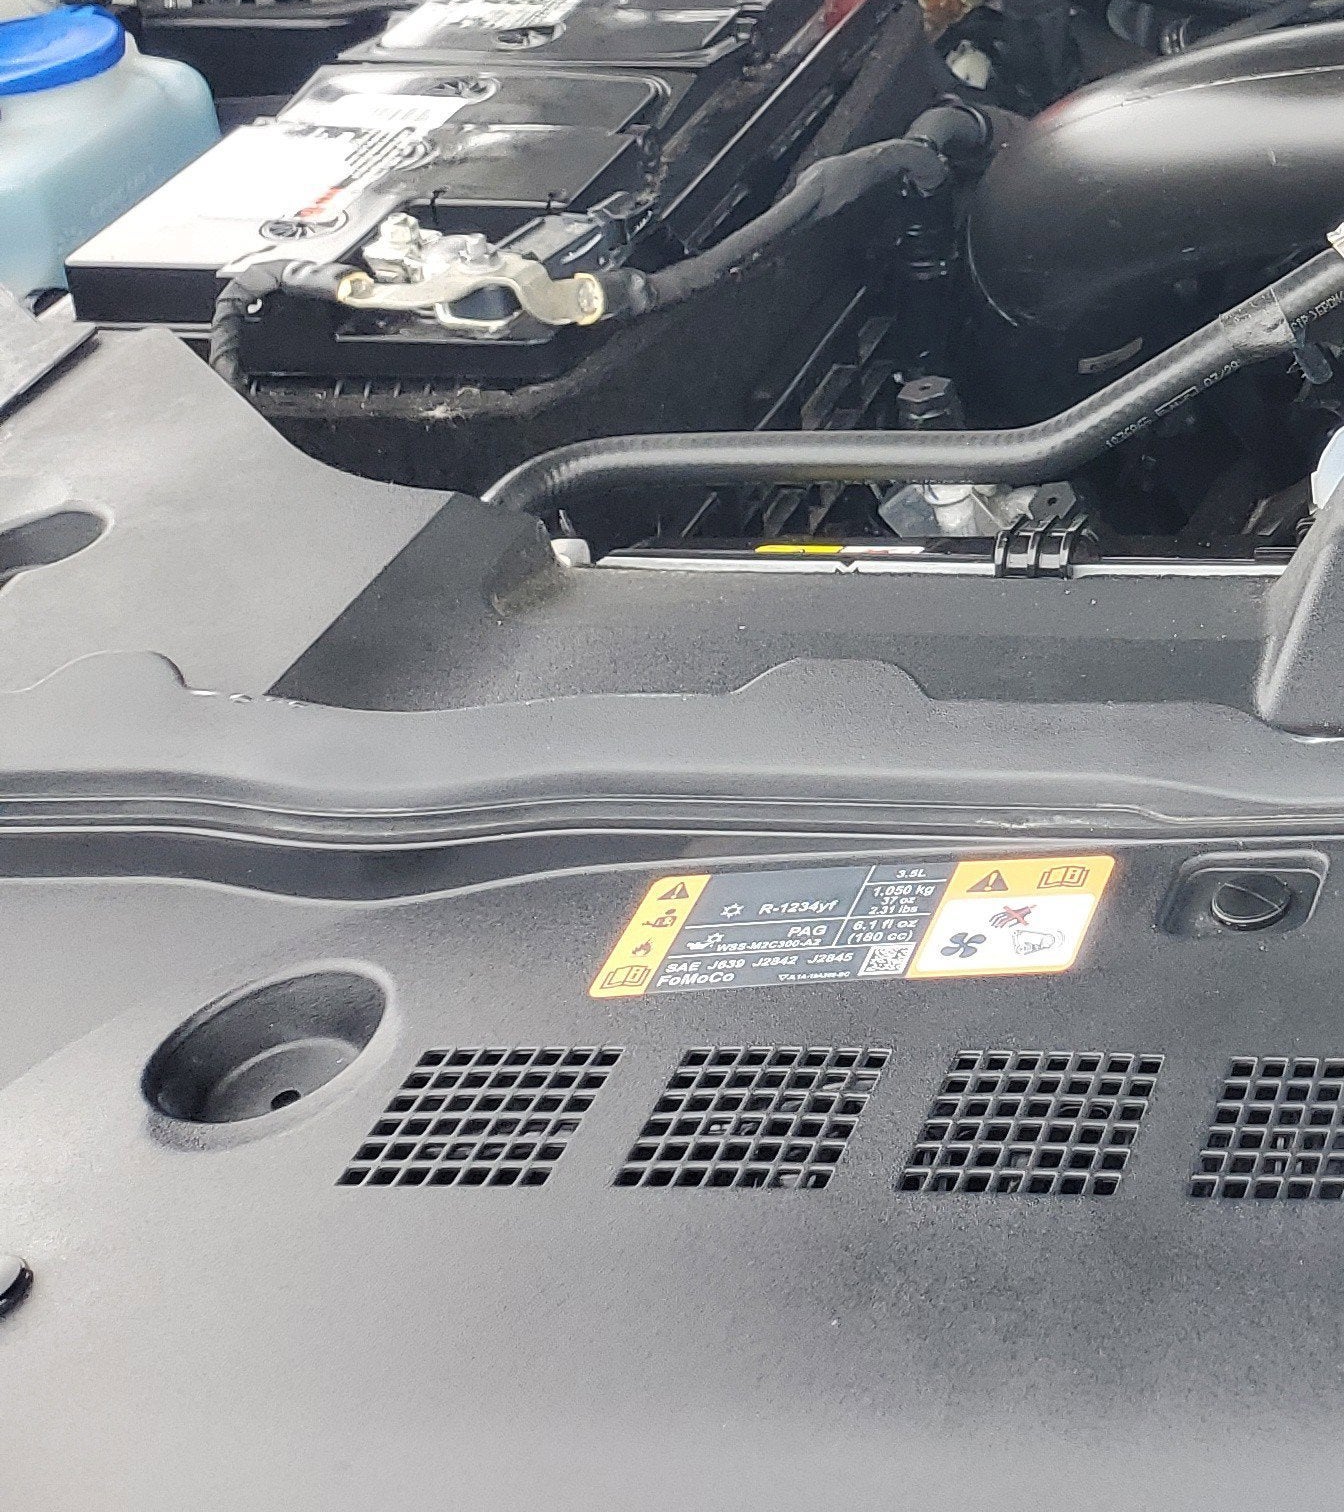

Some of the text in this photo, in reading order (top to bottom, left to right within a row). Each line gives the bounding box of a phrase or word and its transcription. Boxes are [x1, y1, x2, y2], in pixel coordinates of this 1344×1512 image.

[896, 868, 927, 879] 3.5L
[873, 884, 936, 897] 1.050 kg
[758, 899, 841, 915] R-1234yf
[881, 897, 916, 906] 37 oz
[898, 904, 919, 914] lbs
[787, 924, 828, 937] PAG
[853, 919, 919, 931] 6.1 fl oz
[847, 929, 913, 945] (180 cc)
[665, 952, 854, 974] SAE J639 J2842 J2845
[656, 971, 736, 988] FoMoCo
